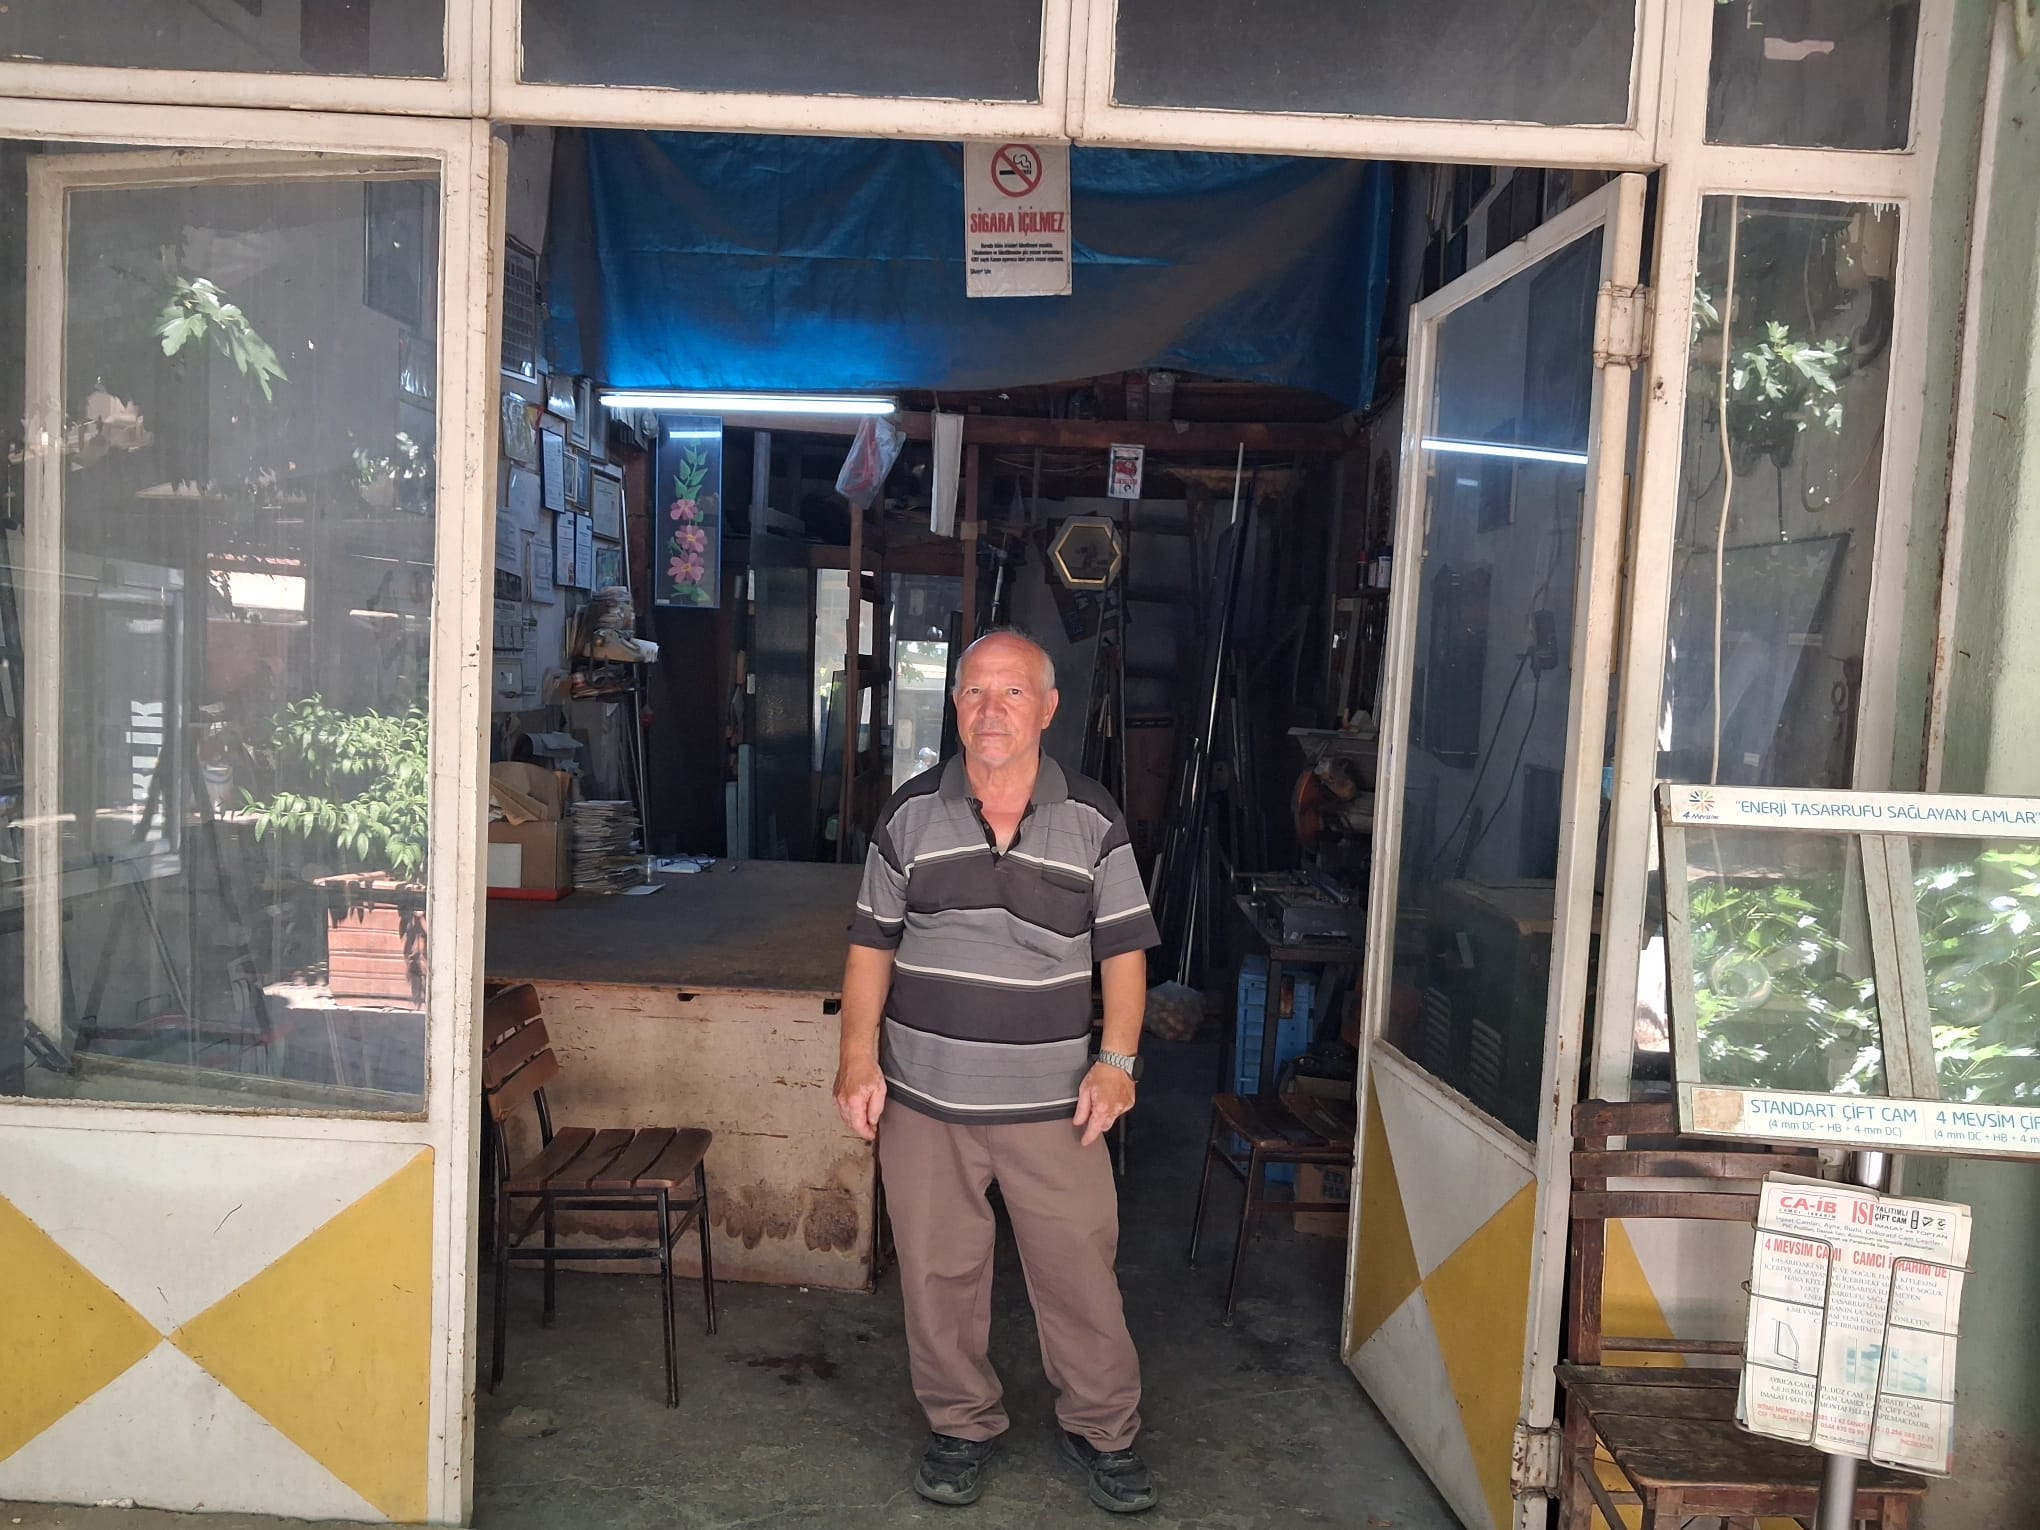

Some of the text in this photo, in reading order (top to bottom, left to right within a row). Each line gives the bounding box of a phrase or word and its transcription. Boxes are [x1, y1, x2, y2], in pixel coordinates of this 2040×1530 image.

[970, 206, 1065, 236] SİGARA İÇİLMEZ
[1683, 811, 1690, 819] 4
[1792, 803, 1883, 818] TASARRUFU
[1887, 804, 1967, 821] SAĞLAYAN
[1751, 1099, 1917, 1123] STANDART ÇİFT CAM
[1936, 1111, 1947, 1124] 4
[1952, 1110, 2015, 1129] MEVSİM
[1781, 1121, 1800, 1130] mm
[1802, 1121, 1816, 1131] DC
[1827, 1123, 1842, 1132] HB
[1854, 1125, 1861, 1133] 4
[1864, 1127, 1883, 1135] mm
[1947, 1131, 1965, 1140] mm
[1968, 1131, 1982, 1141] DC
[1993, 1133, 2008, 1142] HB
[2020, 1134, 2027, 1142] 4
[1852, 1201, 1875, 1226] ISI
[1875, 1212, 1907, 1225] ÇİFT CAM
[1917, 1230, 1948, 1240] TOPTAN
[1765, 1238, 1771, 1251] 4
[1774, 1239, 1813, 1257] MEVSİM
[1853, 1251, 1886, 1268] CAMCI
